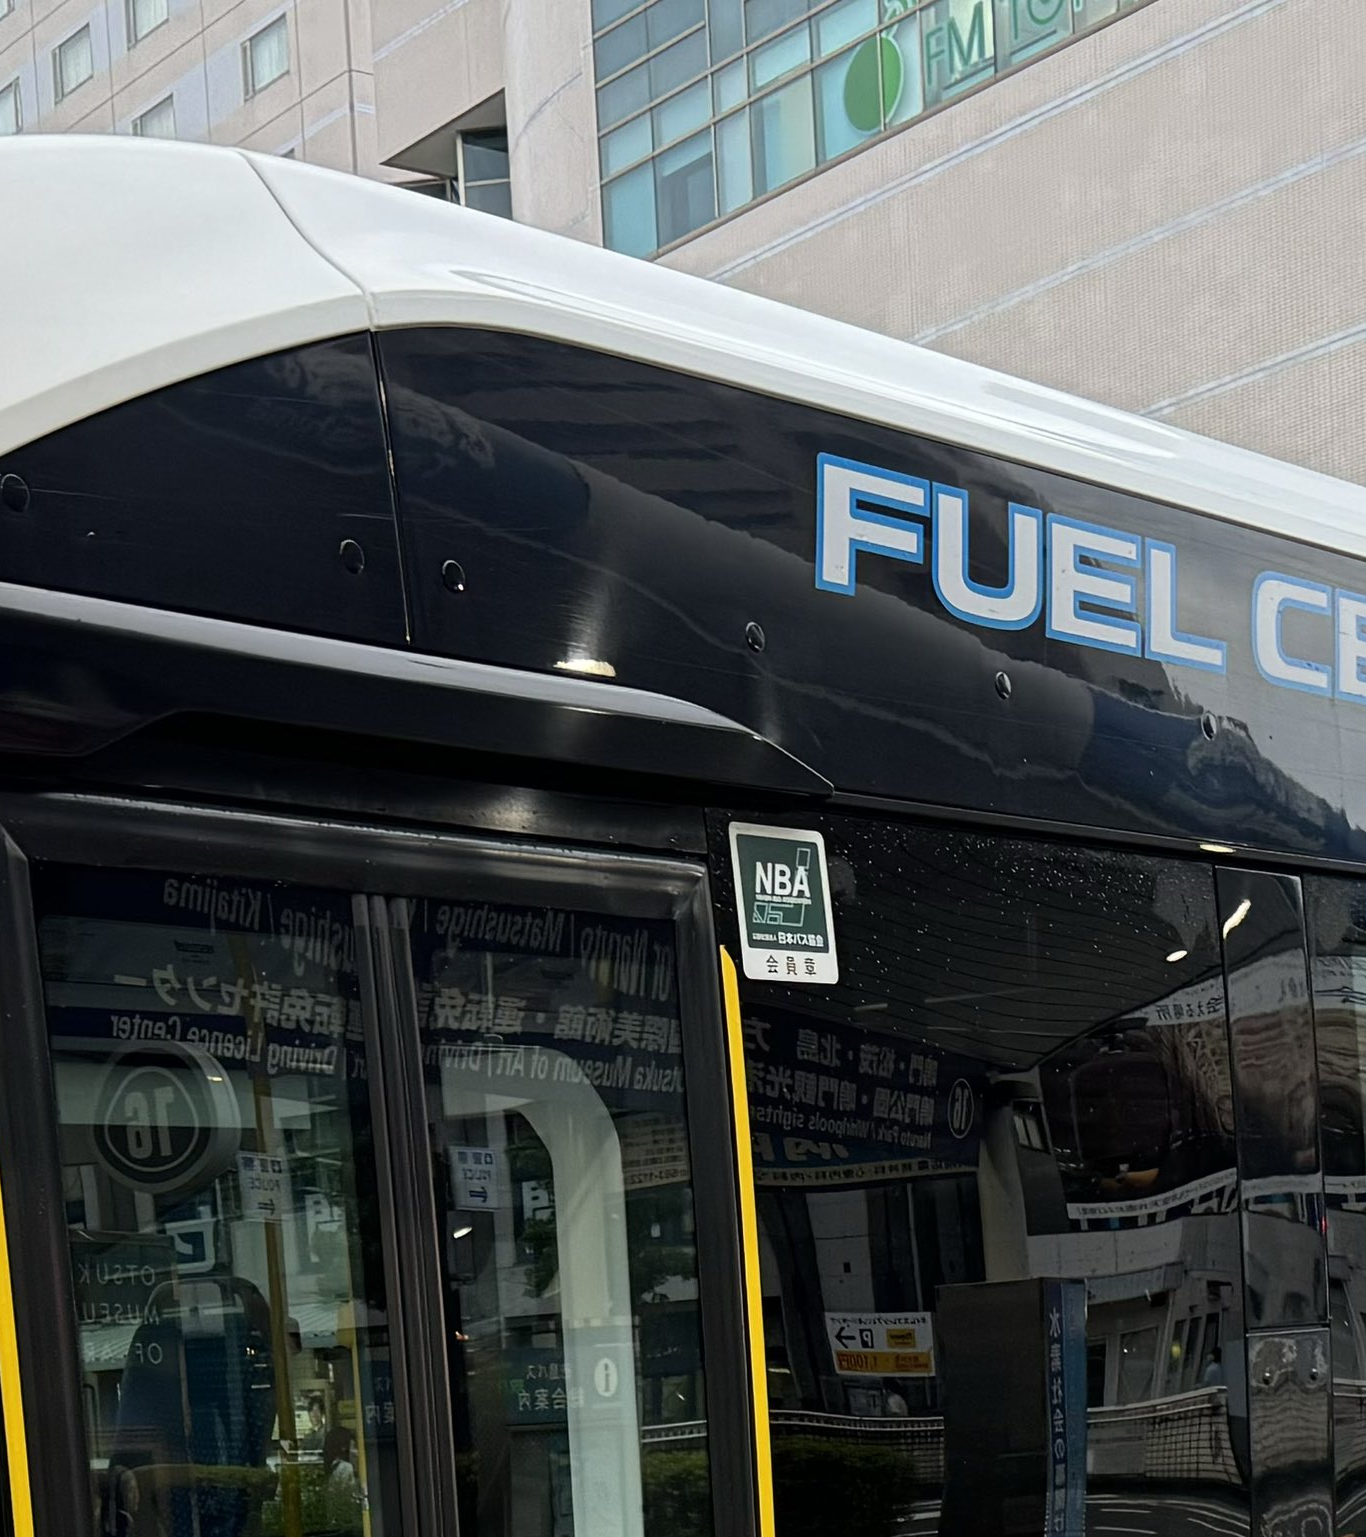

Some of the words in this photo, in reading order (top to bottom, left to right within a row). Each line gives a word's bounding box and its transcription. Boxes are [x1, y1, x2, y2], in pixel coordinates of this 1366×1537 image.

[925, 1, 985, 86] FM
[815, 451, 1227, 675] FUEL
[755, 862, 811, 897] NBA
